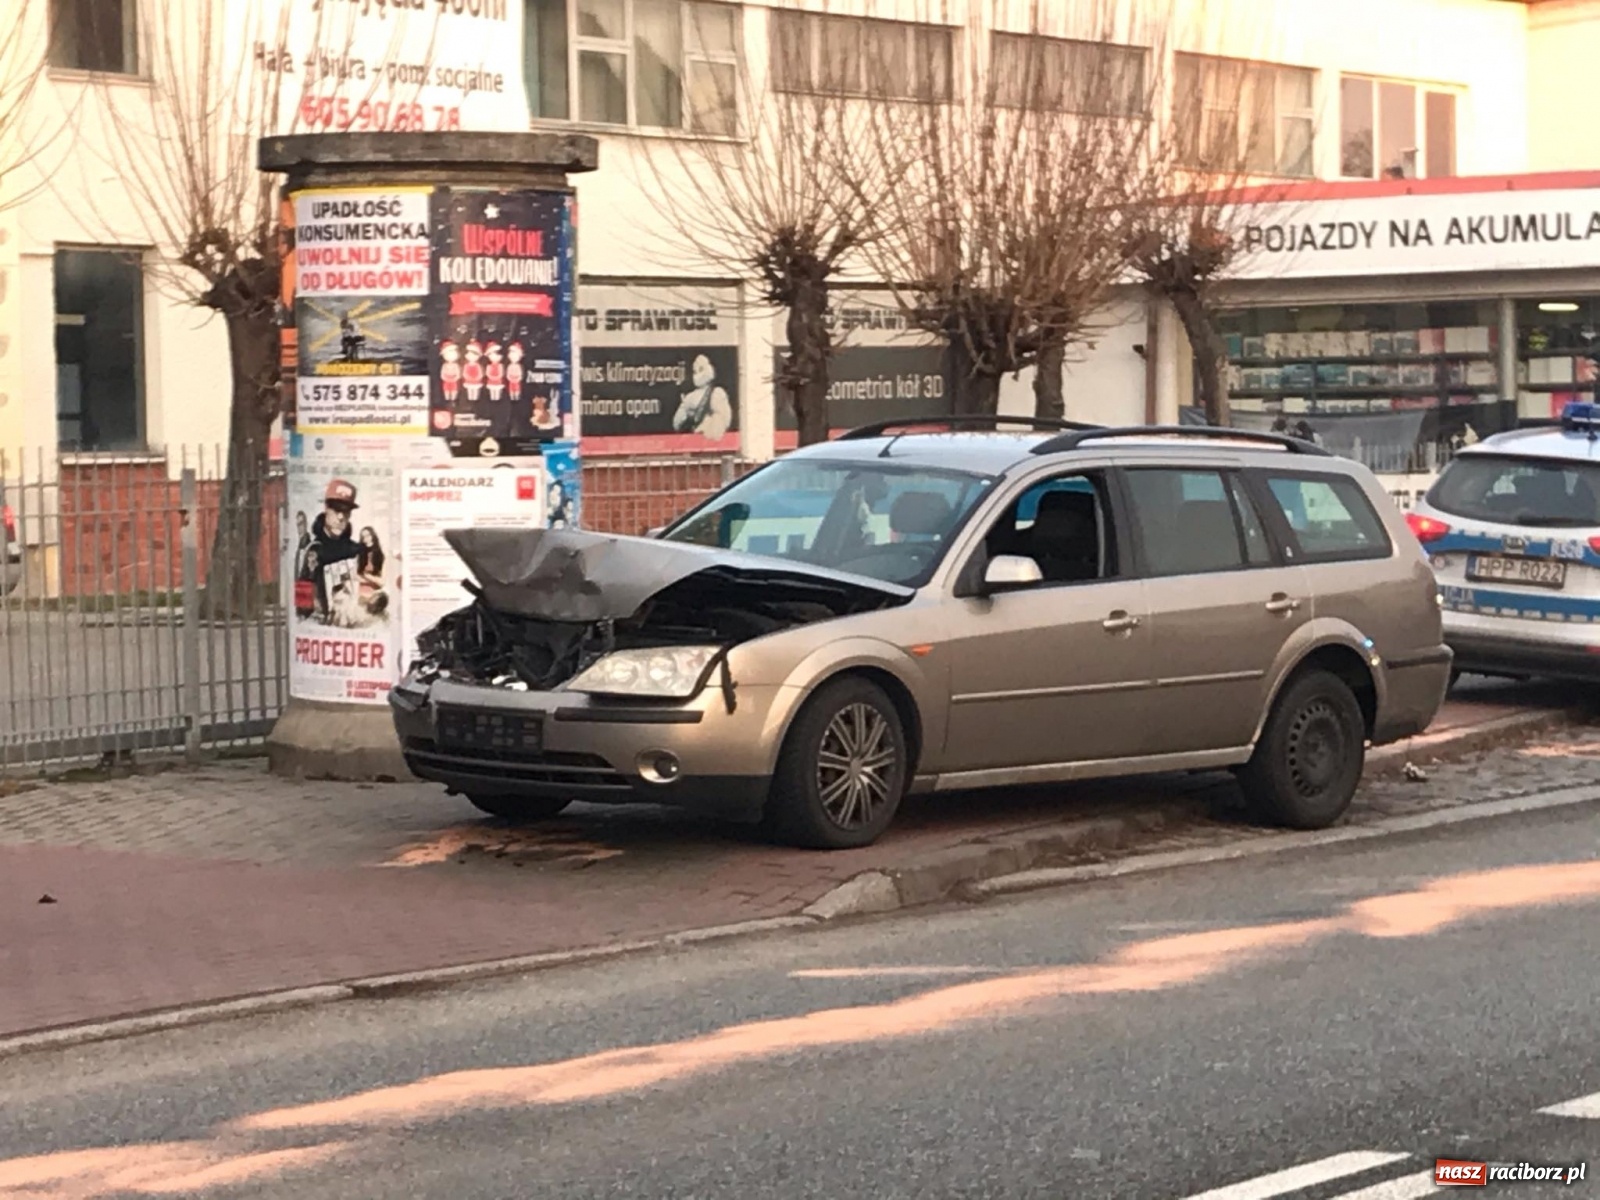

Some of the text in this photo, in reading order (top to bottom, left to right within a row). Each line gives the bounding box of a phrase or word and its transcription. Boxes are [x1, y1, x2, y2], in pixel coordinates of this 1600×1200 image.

[436, 61, 503, 98] socjalne
[312, 195, 401, 219] UPADŁOŚĆ
[297, 222, 430, 242] KONSUMENCKA
[1245, 212, 1600, 253] POJAZDY NA AKUMULA
[297, 245, 381, 266] UWOLNIJ
[301, 266, 424, 291] OD DŁUGÓW!
[607, 361, 686, 386] klimatyzacji
[313, 383, 425, 401] 575 874 344
[923, 374, 944, 398] 3D
[626, 398, 660, 419] opon
[409, 477, 494, 488] KALENDARZ
[409, 490, 462, 501] IMPREZ
[295, 636, 385, 669] PROCEDER
